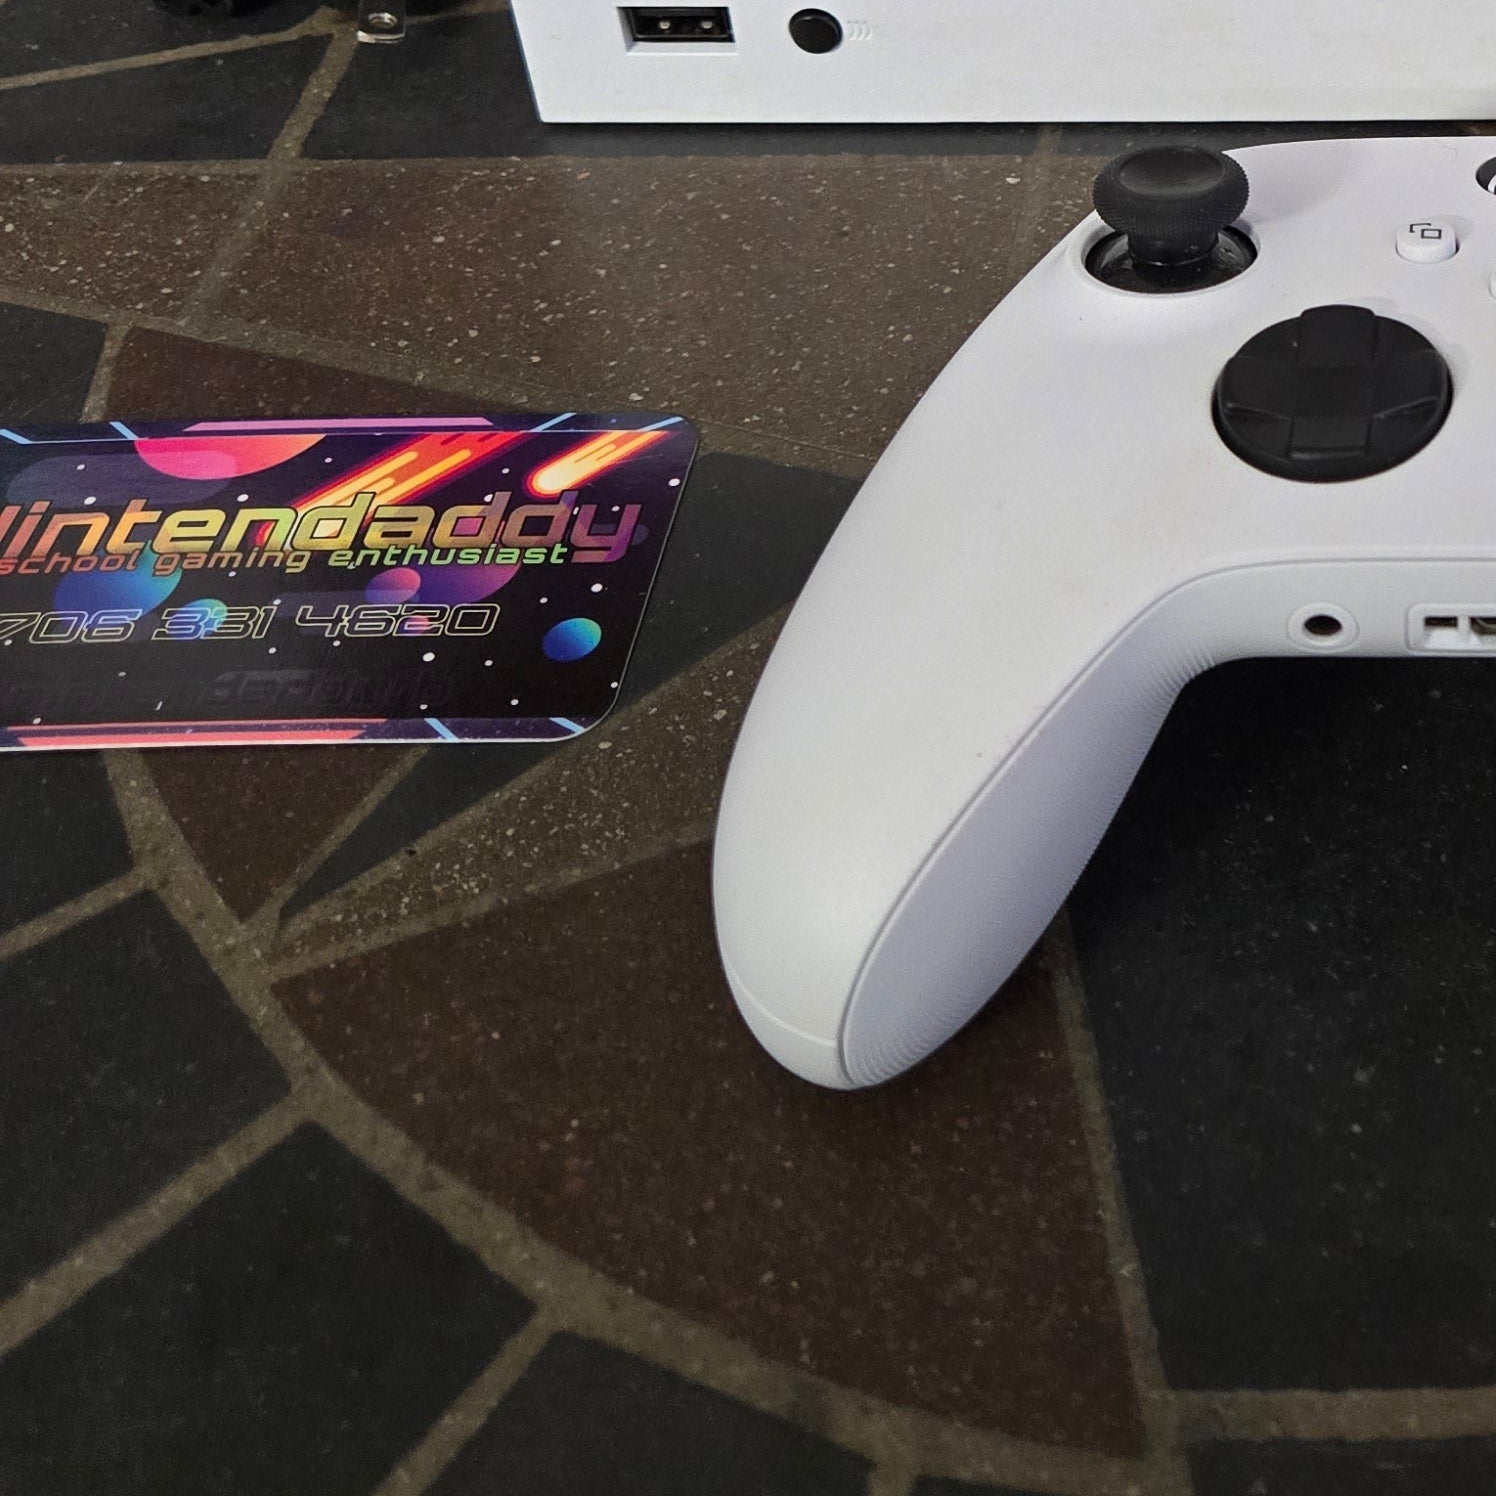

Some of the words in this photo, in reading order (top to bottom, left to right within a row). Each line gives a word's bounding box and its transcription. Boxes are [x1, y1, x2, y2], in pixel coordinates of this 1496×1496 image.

[0, 549, 139, 576] school
[152, 546, 312, 577] gaming
[328, 543, 567, 567] enthusiast
[151, 605, 278, 641] 331
[294, 603, 501, 638] 4620
